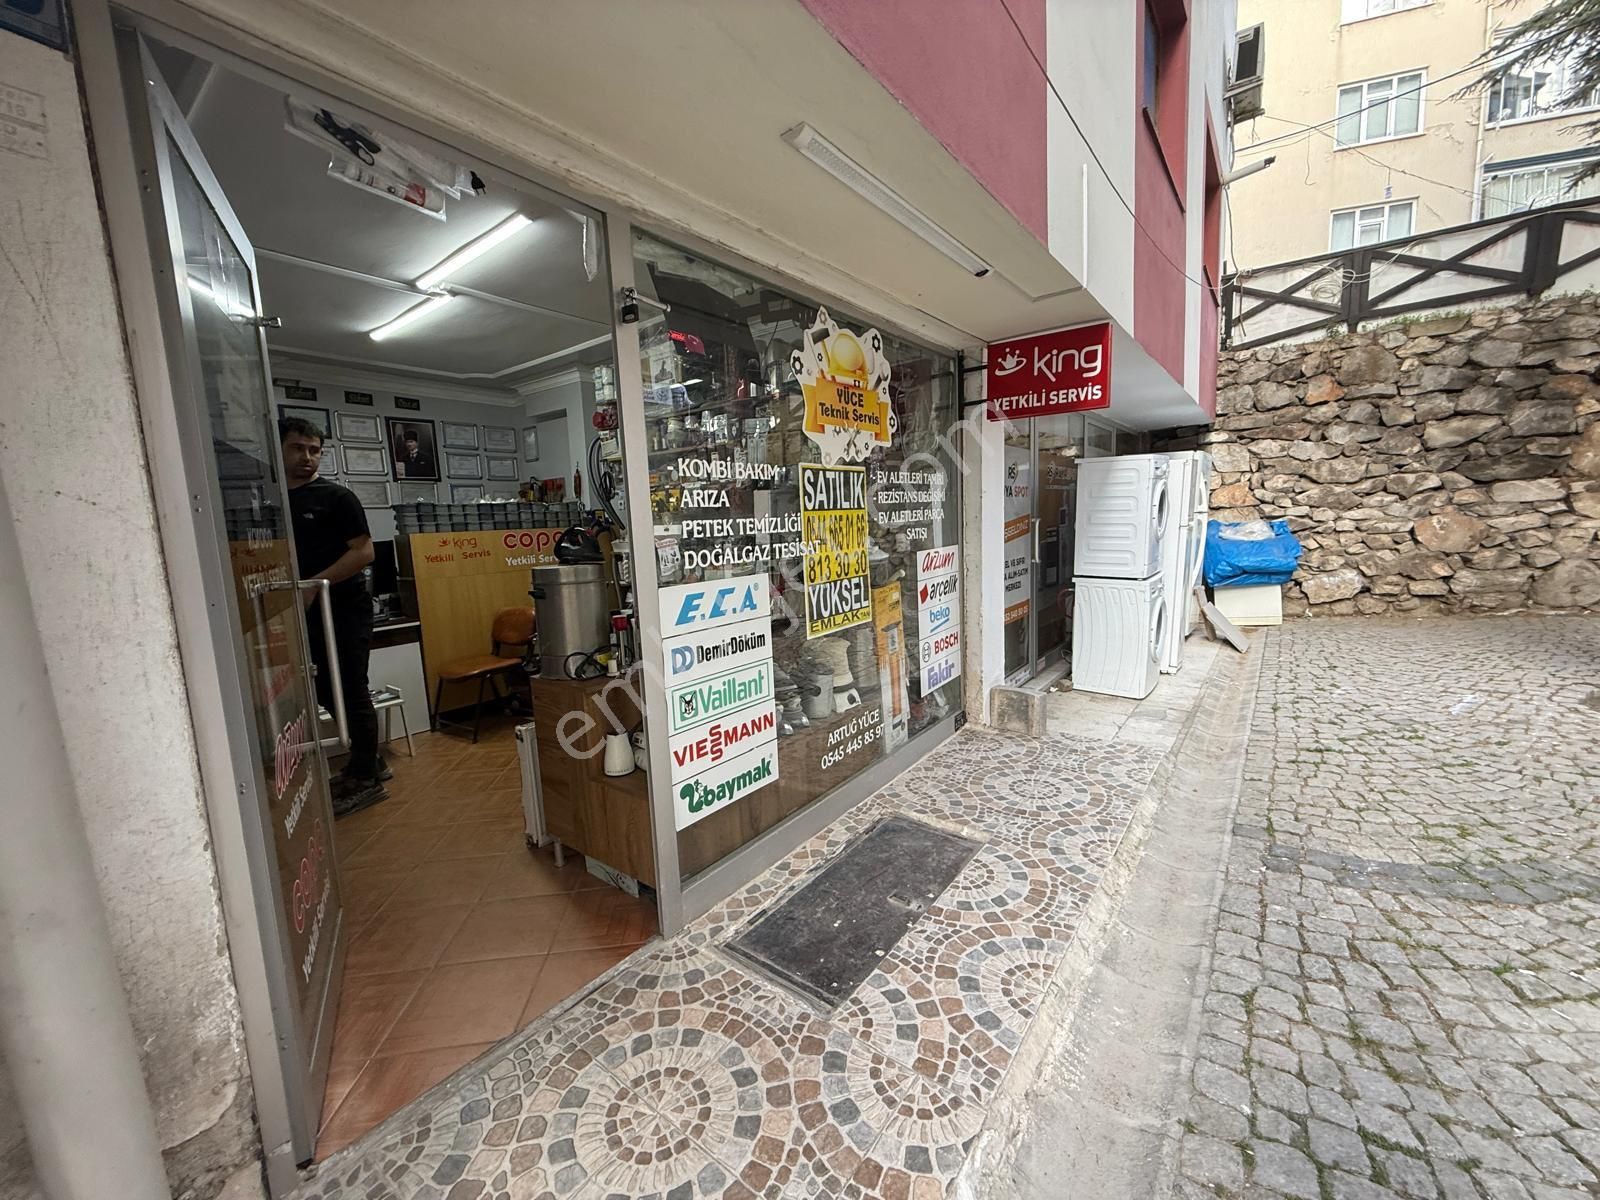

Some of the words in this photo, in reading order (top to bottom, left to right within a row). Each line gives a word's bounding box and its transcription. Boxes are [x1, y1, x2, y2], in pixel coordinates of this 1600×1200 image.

[1034, 344, 1102, 382] king
[836, 386, 865, 408] YÜCE
[993, 390, 1046, 411] YETKİLİ
[1049, 382, 1102, 405] SERVİS
[819, 402, 850, 420] Teknik
[852, 408, 880, 426] Servis
[677, 457, 732, 478] KOMBİ
[735, 462, 778, 480] BAKIM
[877, 471, 888, 484] EV
[889, 470, 923, 484] ALETLERİ
[680, 489, 730, 508] ARIZA
[804, 469, 865, 511] SATILIK
[878, 489, 917, 504] REZİSTANS
[1014, 486, 1029, 498] SPOT
[682, 519, 734, 539] PETEK
[736, 512, 801, 536] TEMİZLİĞİ
[878, 511, 890, 525] EV
[890, 507, 923, 523] ALETLERİ
[453, 537, 478, 550] king
[845, 514, 854, 552] 01
[906, 527, 928, 542] SATIŞI
[424, 554, 454, 563] Yetkili
[461, 549, 491, 560] Servis
[505, 554, 536, 566] Yetkili
[684, 544, 771, 569] DOĞALGAZ
[808, 554, 831, 583] 813
[835, 552, 850, 578] 30
[854, 550, 867, 575] 30
[921, 550, 955, 574] arzum
[929, 574, 958, 602] arçelik
[810, 610, 861, 634] EMLAK
[929, 606, 950, 624] beko
[696, 632, 766, 664] DemirDöküm
[934, 631, 959, 655] BOSCH
[927, 659, 955, 689] Fakir
[698, 669, 764, 713] Vaillant
[673, 712, 774, 768] VIESSMANN
[827, 718, 858, 748] ARTUĞ
[858, 708, 880, 729] YÜCE
[821, 745, 845, 770] 0545
[845, 736, 863, 755] 445
[864, 731, 874, 745] 85
[703, 757, 772, 806] baymak
